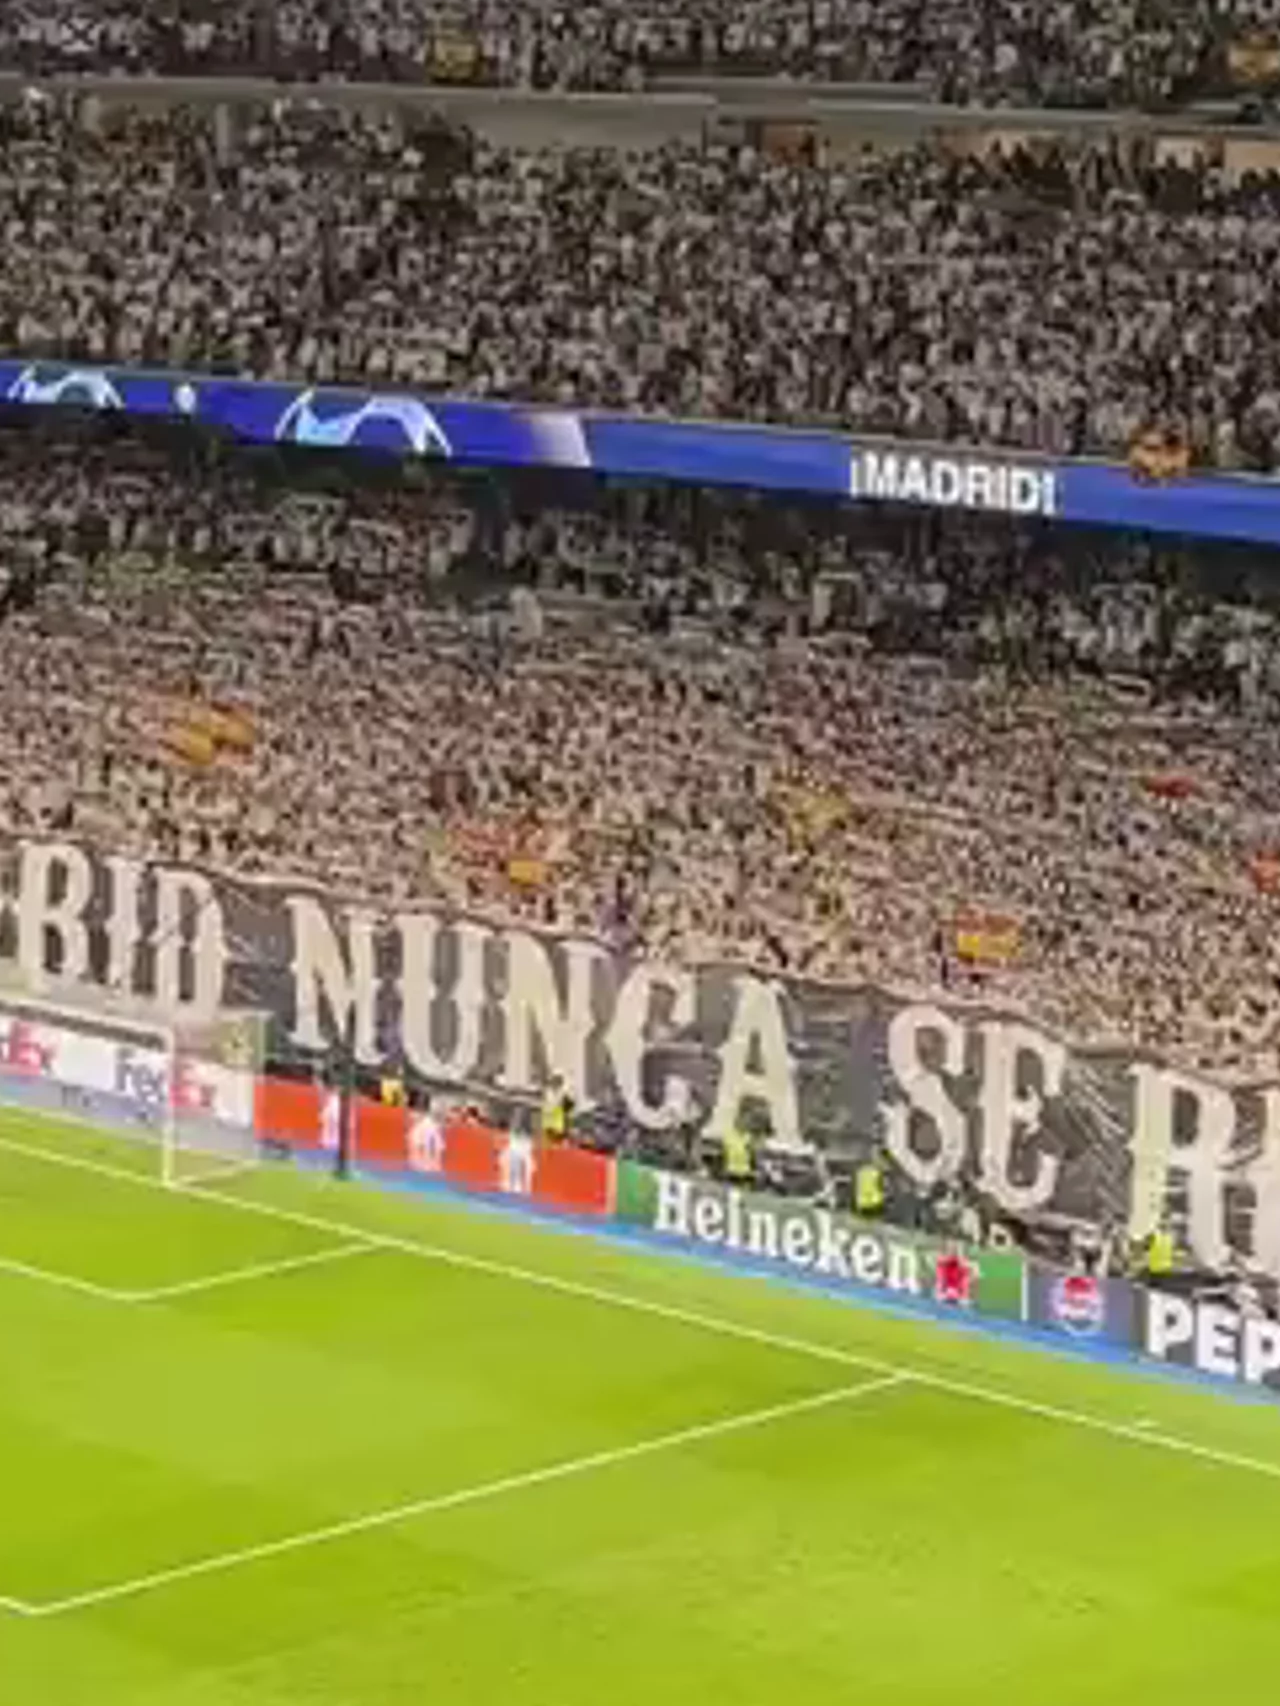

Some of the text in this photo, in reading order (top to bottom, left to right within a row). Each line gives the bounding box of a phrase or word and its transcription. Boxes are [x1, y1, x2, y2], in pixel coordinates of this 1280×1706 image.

[286, 894, 816, 1155] NUNCA
[882, 1003, 1065, 1212] SE
[653, 1171, 921, 1294] Heineken
